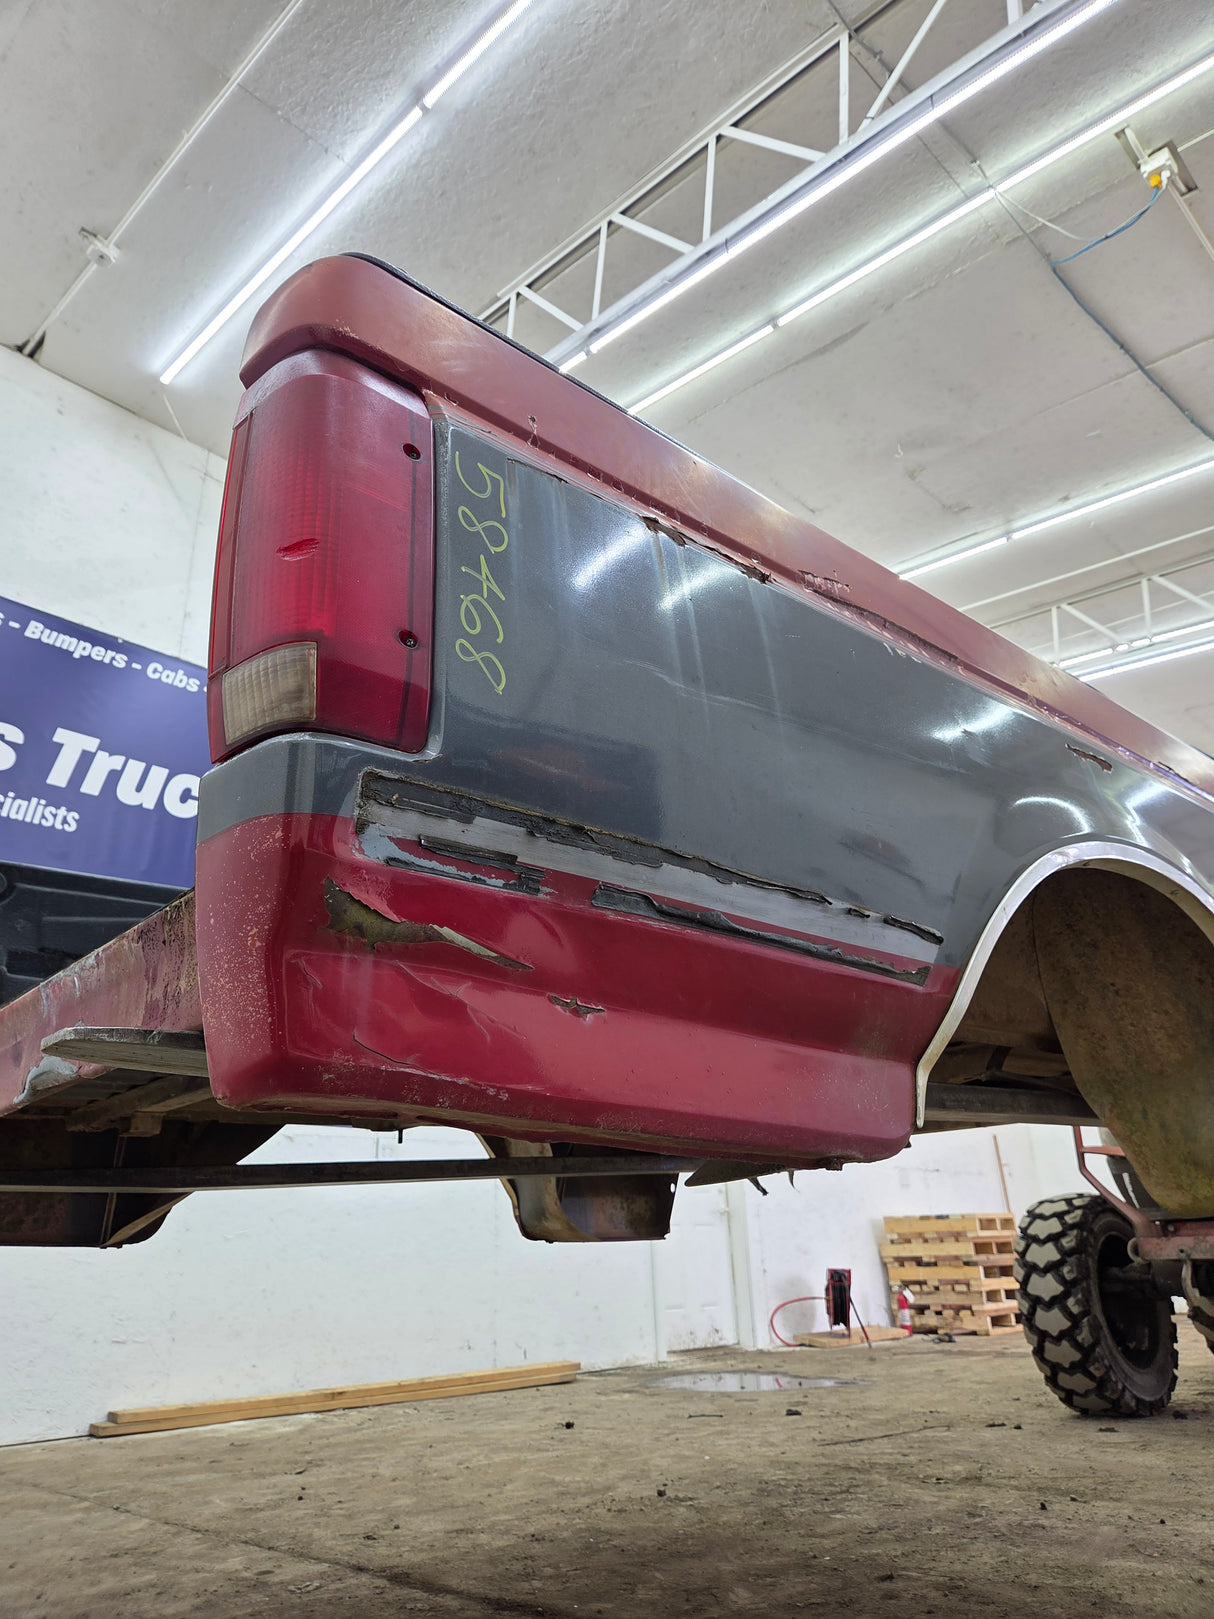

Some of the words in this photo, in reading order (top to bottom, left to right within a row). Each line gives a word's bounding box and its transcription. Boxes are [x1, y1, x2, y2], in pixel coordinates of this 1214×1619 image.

[455, 450, 509, 694] 58468
[24, 620, 128, 669] Bumpers
[146, 662, 200, 693] Cabs
